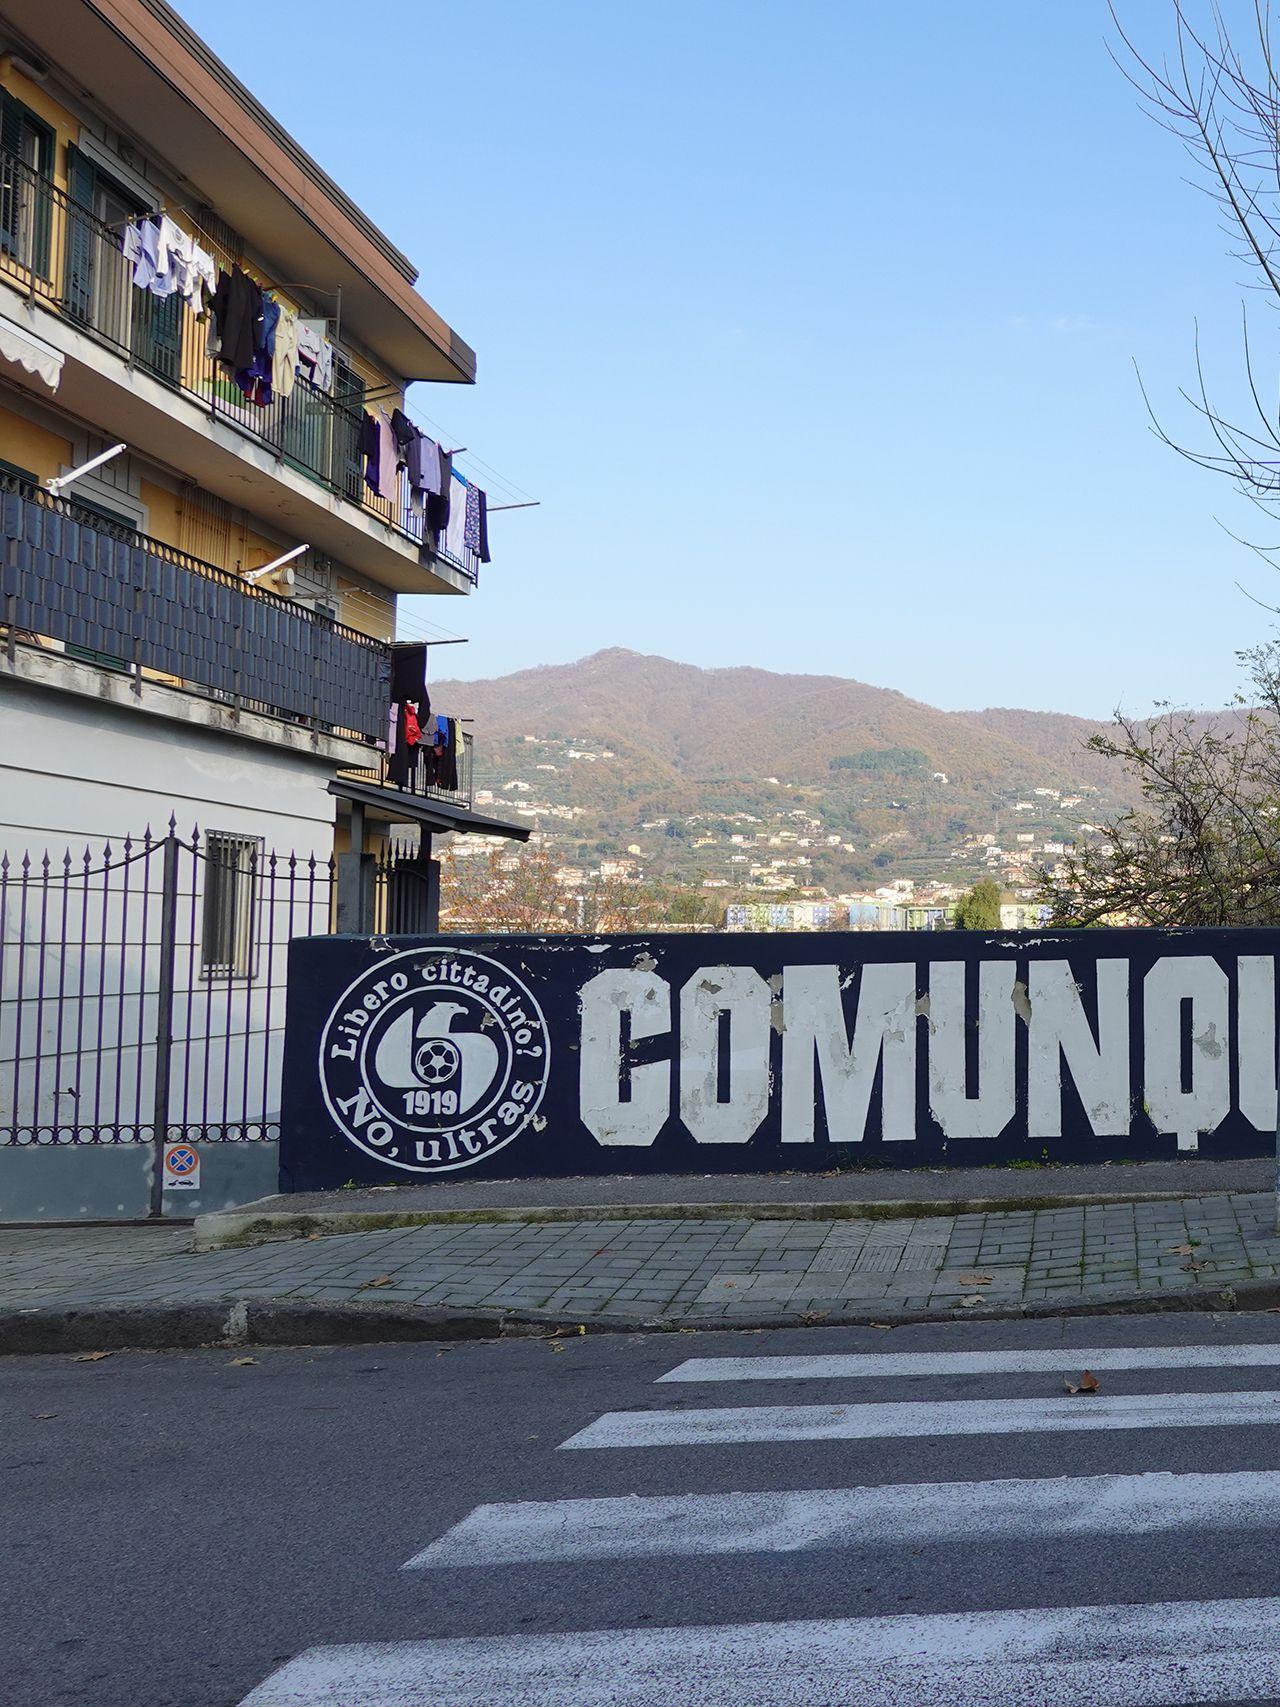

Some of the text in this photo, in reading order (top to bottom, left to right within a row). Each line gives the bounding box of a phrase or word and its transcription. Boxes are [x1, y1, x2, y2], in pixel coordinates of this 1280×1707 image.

[331, 958, 543, 1061] Libero cittadino?
[335, 1079, 535, 1162] No, ultras
[402, 1090, 458, 1115] 1919
